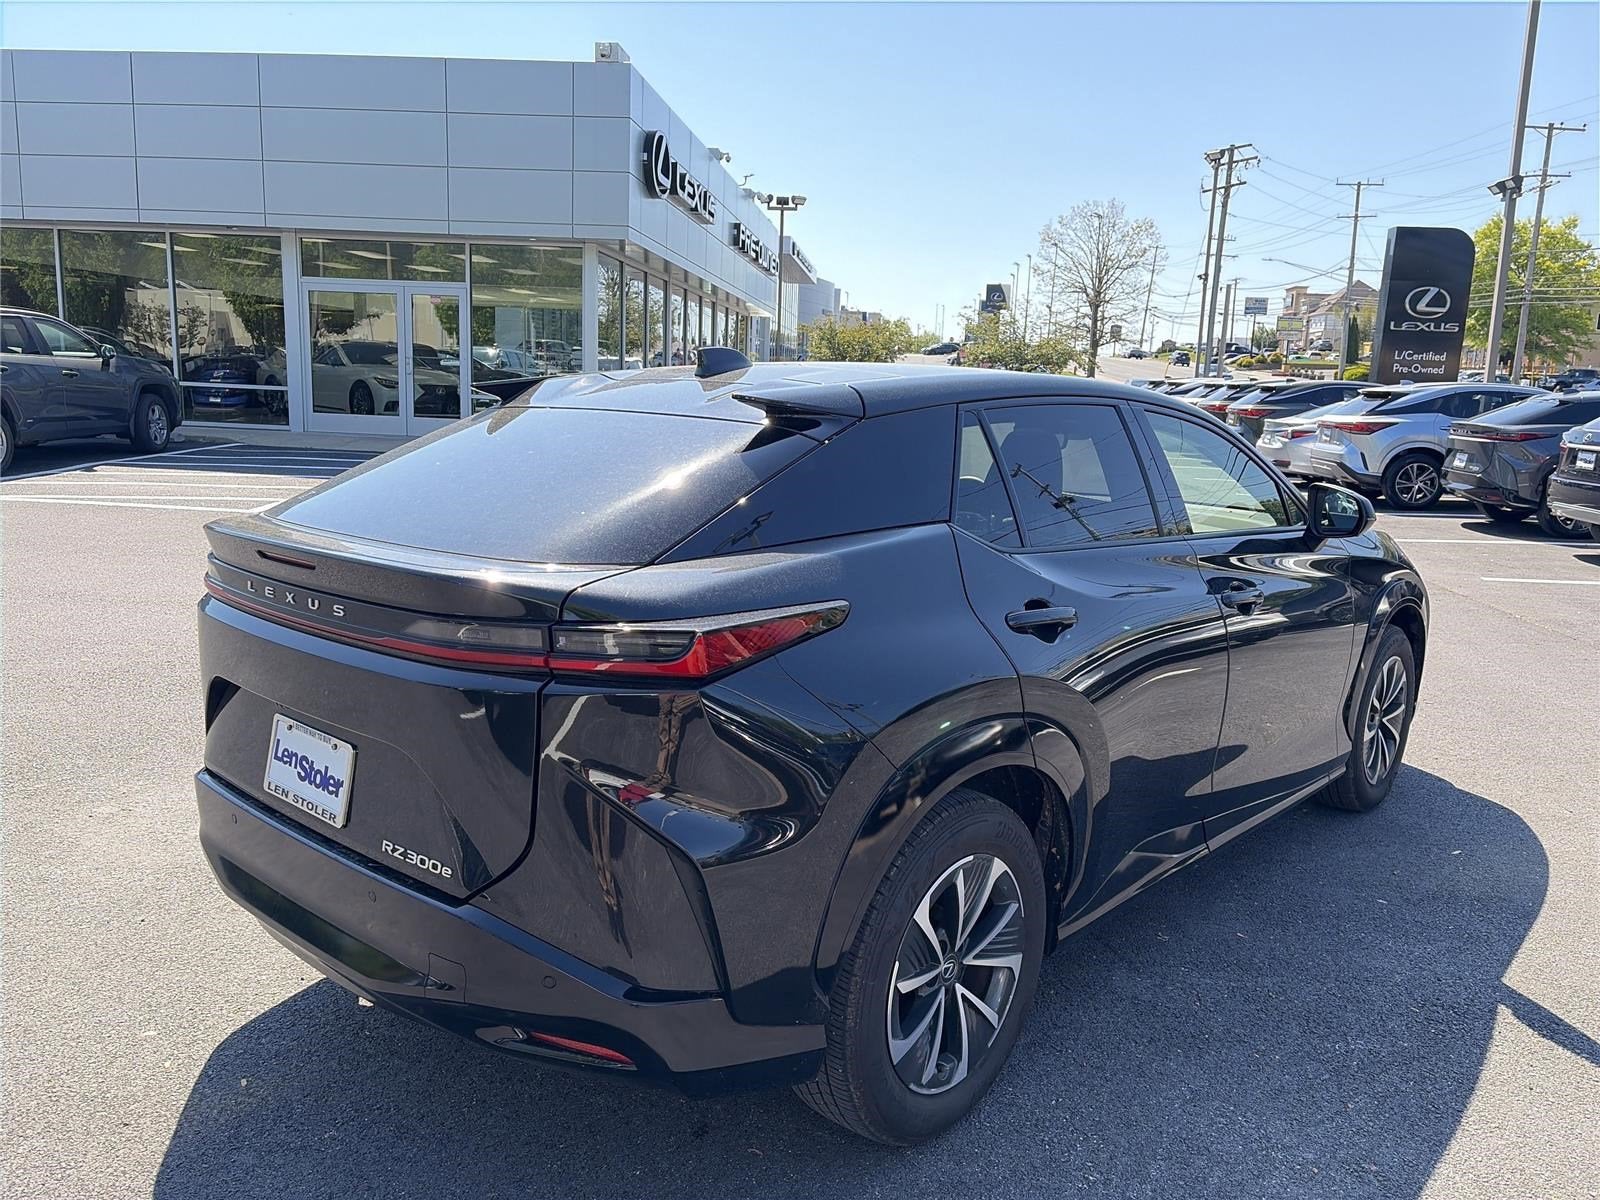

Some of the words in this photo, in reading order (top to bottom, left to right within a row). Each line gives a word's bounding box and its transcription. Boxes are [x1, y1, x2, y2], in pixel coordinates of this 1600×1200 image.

[674, 161, 716, 224] LEXUS
[1390, 321, 1459, 332] LEXUS
[1394, 350, 1447, 361] L/Certified
[1393, 363, 1445, 374] Pre-Owned
[247, 580, 345, 617] LEXUS
[267, 781, 289, 799] LEN
[292, 794, 337, 824] STOLER
